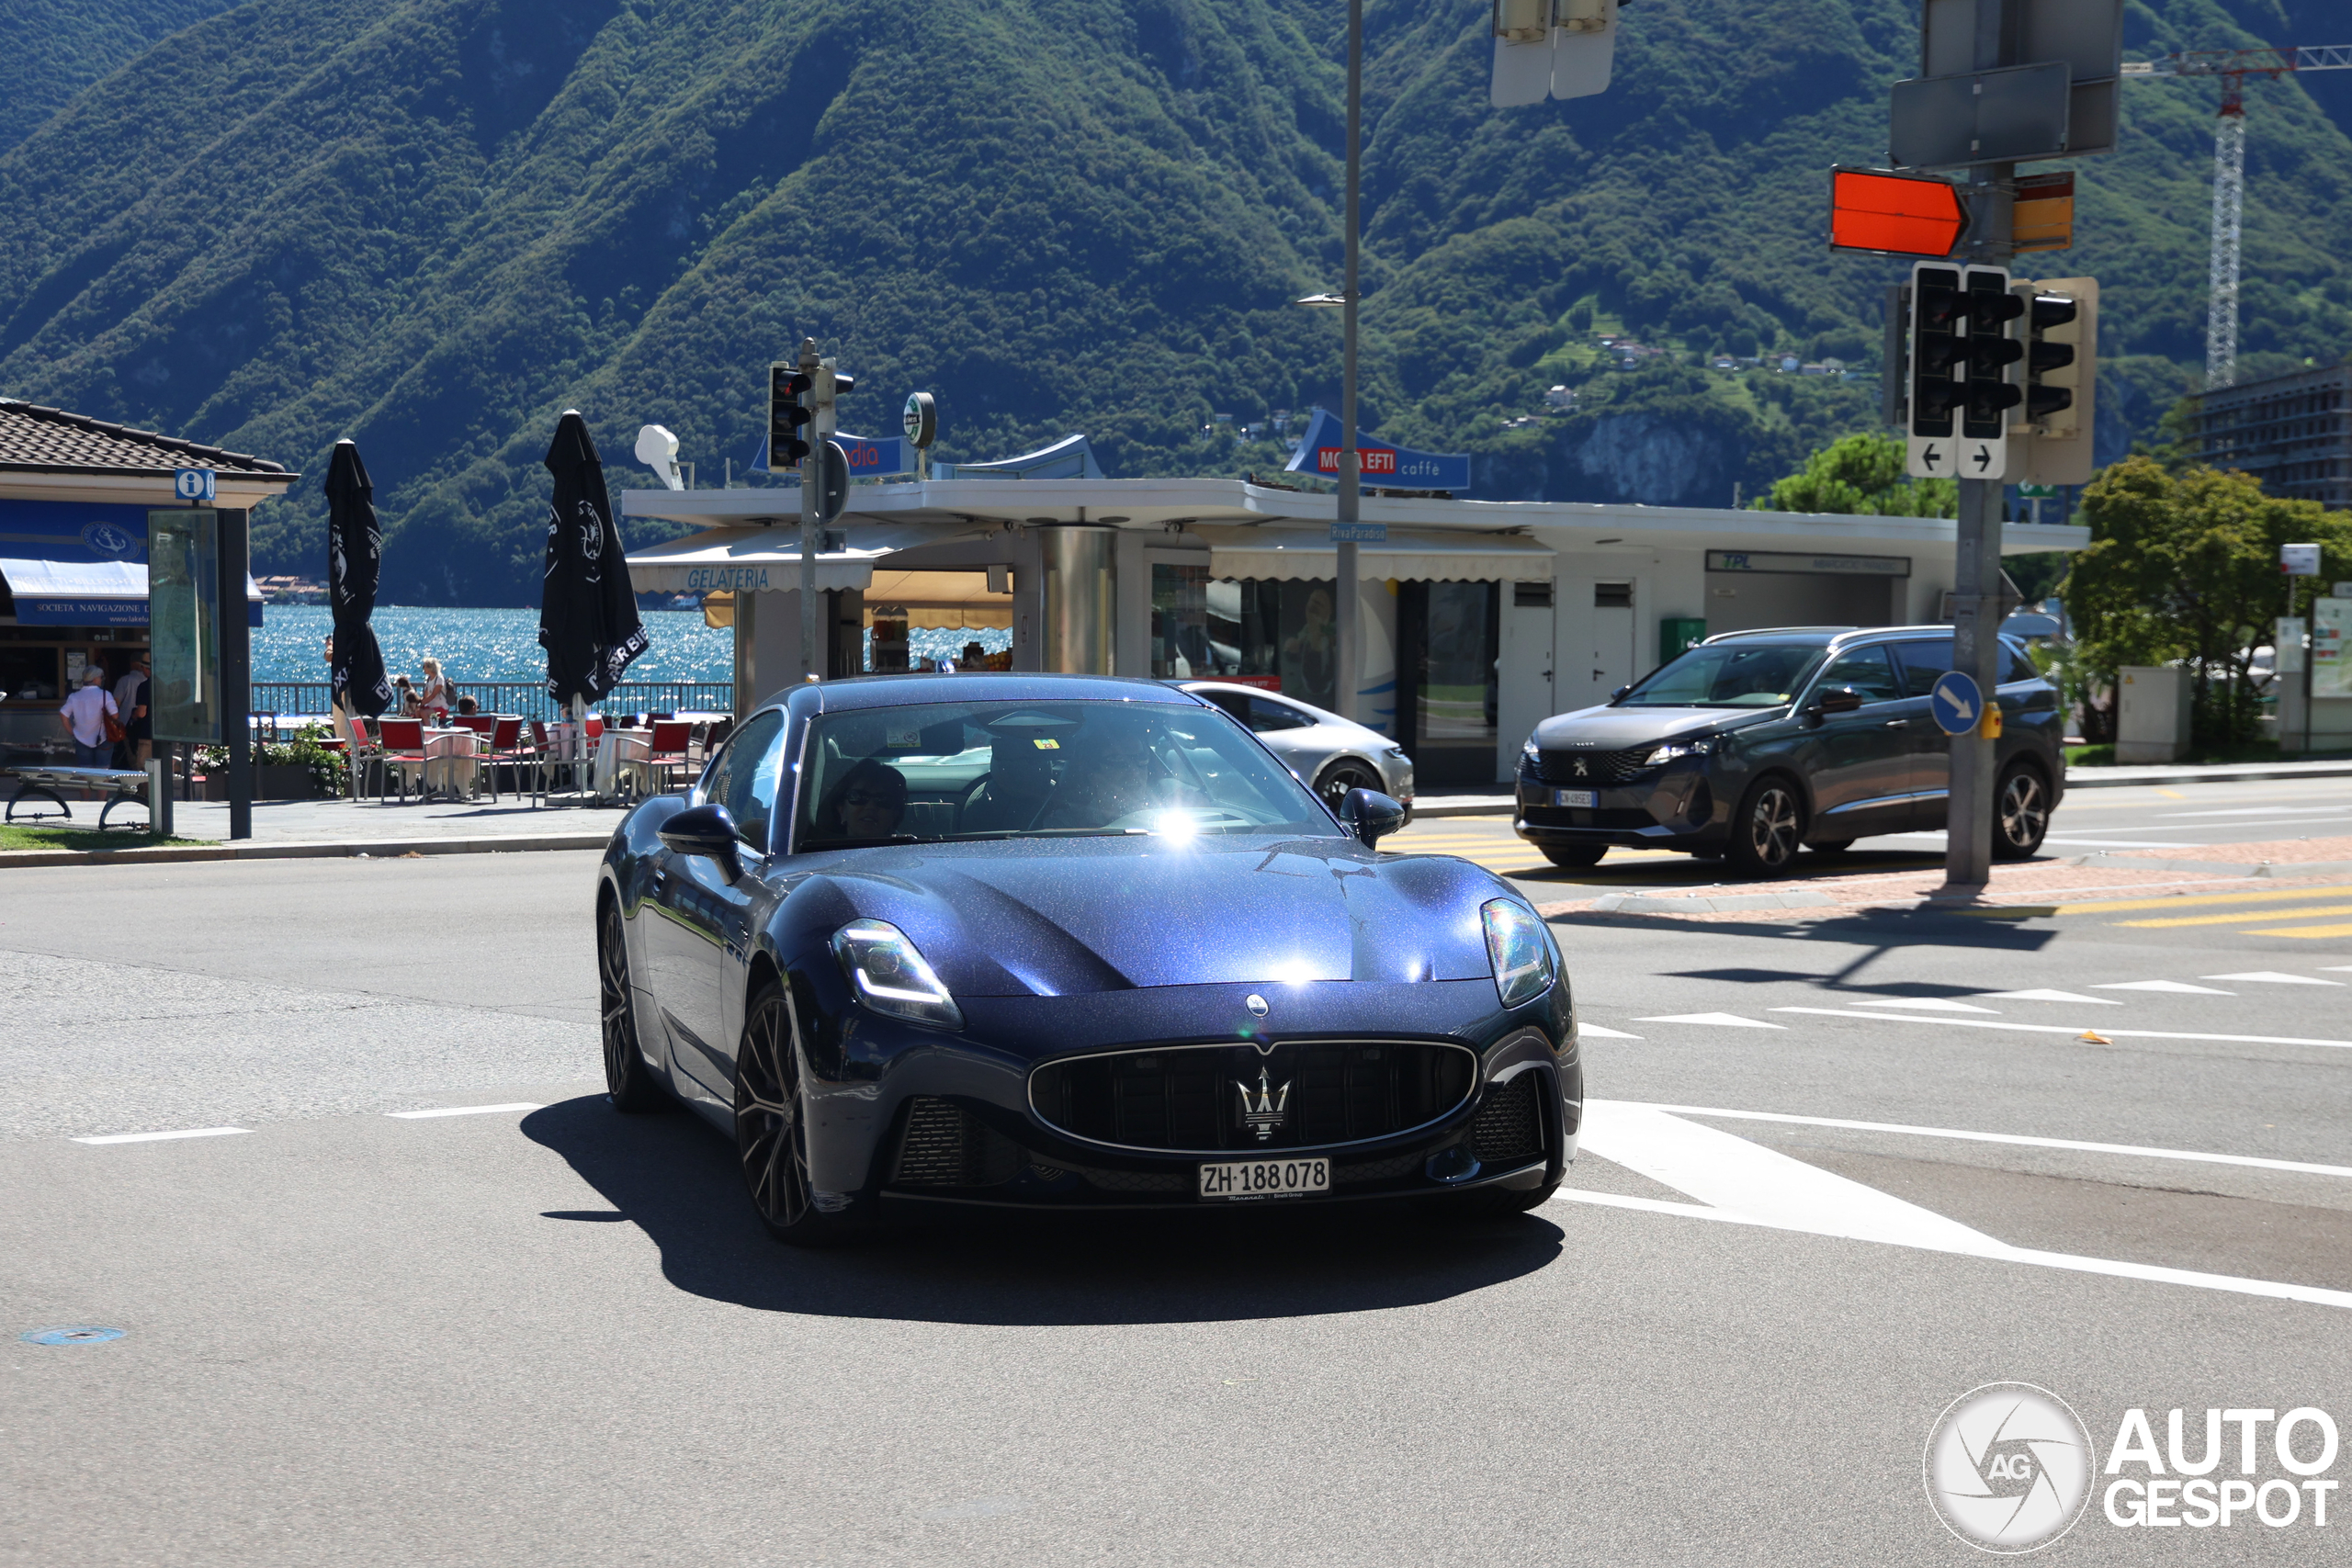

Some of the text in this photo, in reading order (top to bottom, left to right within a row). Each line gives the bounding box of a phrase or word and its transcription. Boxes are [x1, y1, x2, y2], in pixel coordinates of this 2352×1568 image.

[1320, 451, 1394, 469] MOA EFTI
[1401, 461, 1440, 476] caffè
[1332, 525, 1385, 539] Riva Paradiso
[687, 569, 769, 588] GELATERIA
[79, 604, 141, 613] NAVIGAZIONE
